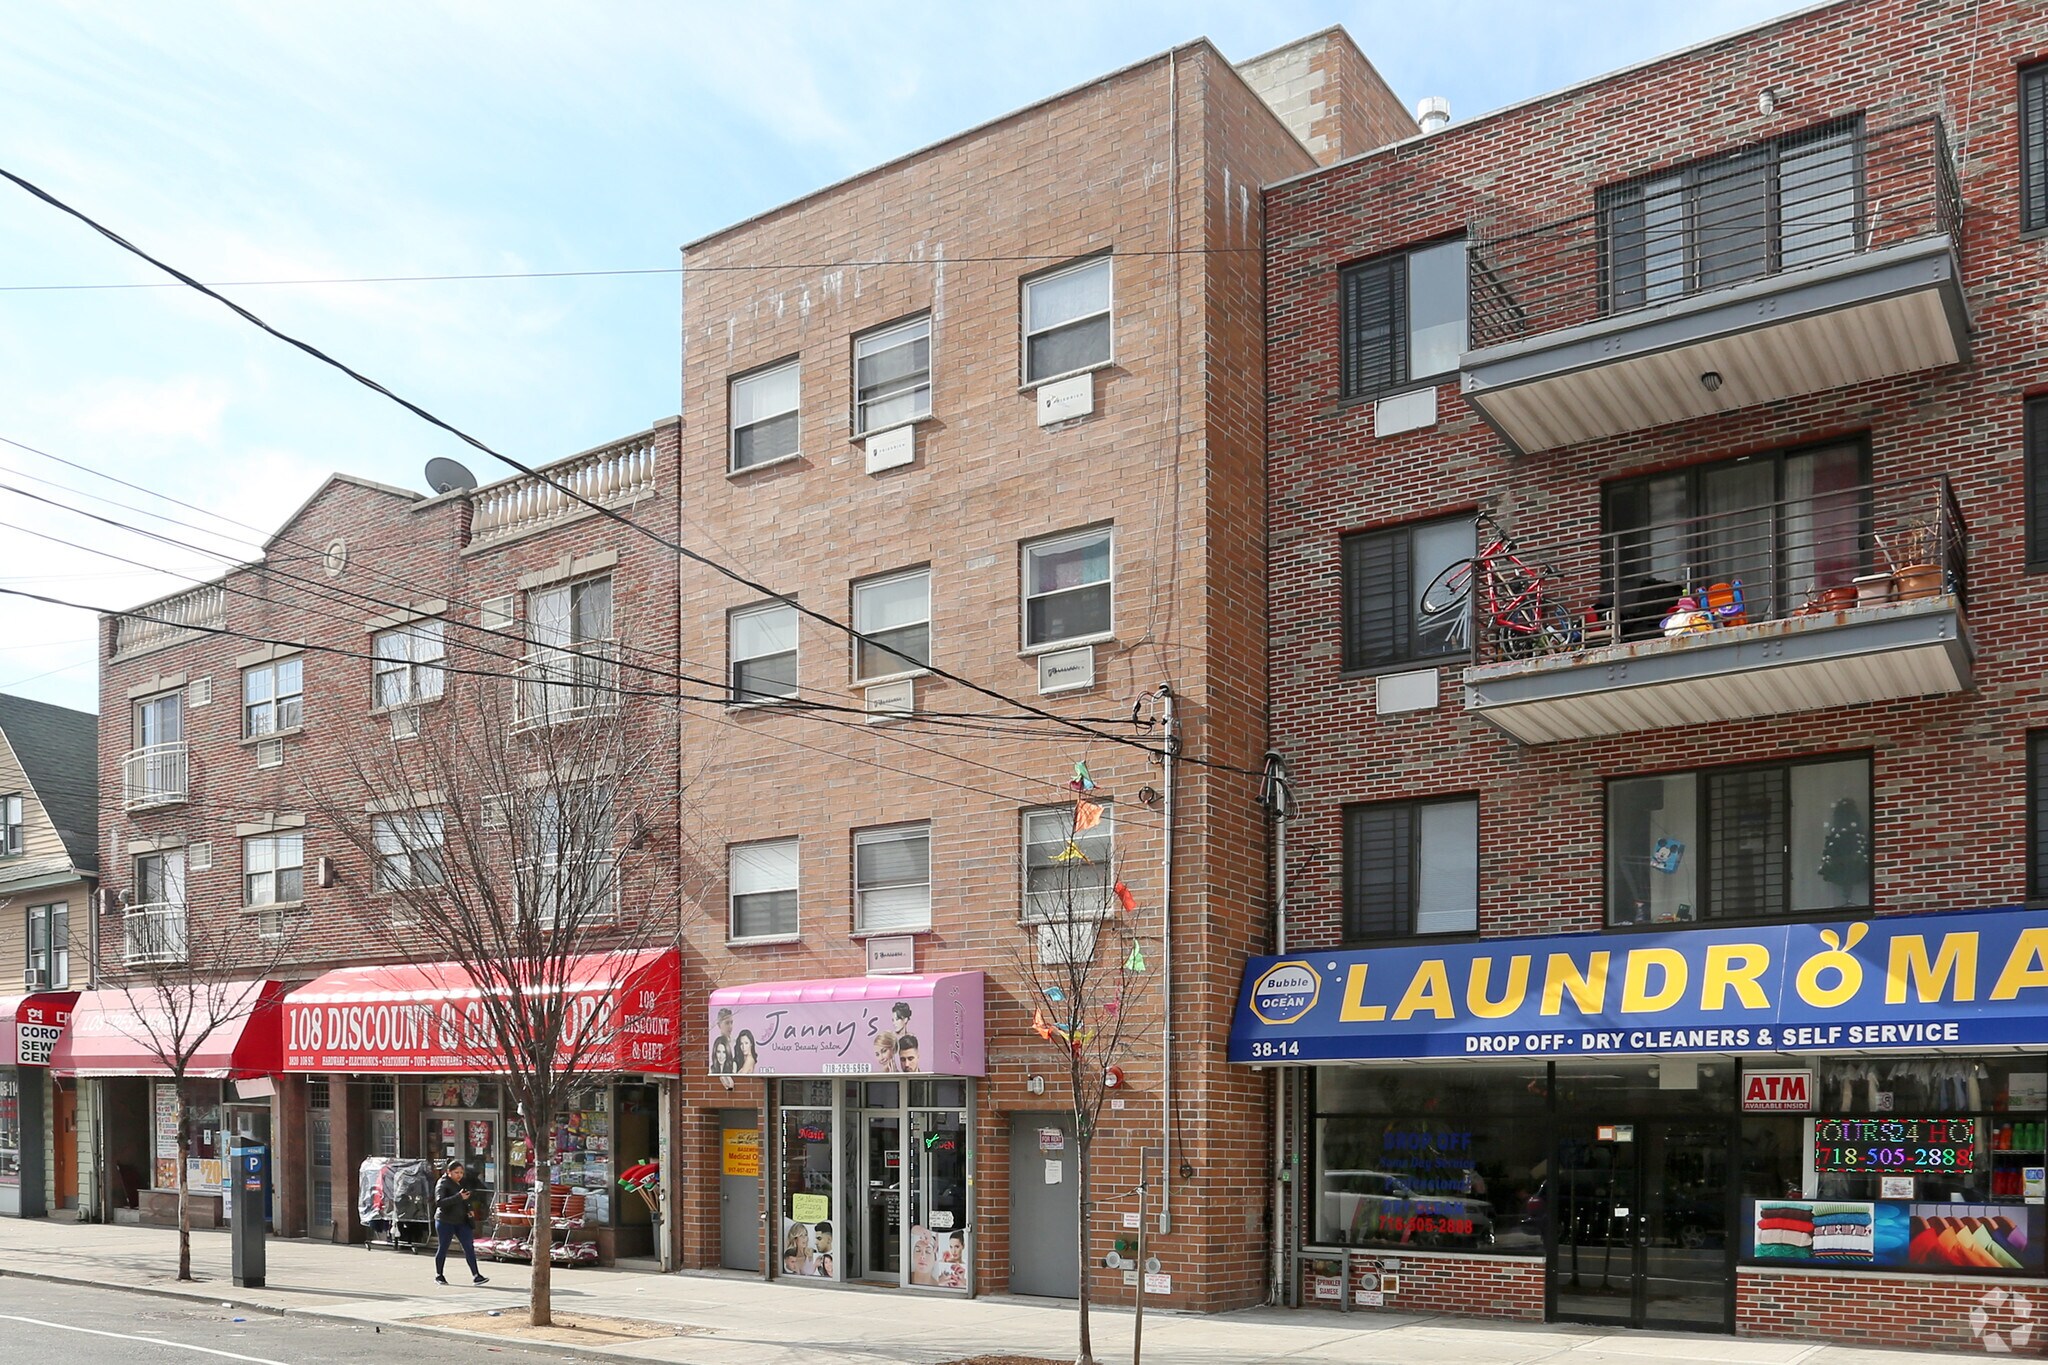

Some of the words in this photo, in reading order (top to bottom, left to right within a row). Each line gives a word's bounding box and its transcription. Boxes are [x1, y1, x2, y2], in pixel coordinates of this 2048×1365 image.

[1267, 978, 1309, 988] Bubble
[639, 990, 655, 1009] 108
[1262, 997, 1305, 1008] OCEAN
[21, 1026, 62, 1039] CORO
[288, 1007, 322, 1051] 108
[326, 1005, 433, 1051] DISCOUNT
[439, 1002, 459, 1051] &
[624, 1015, 669, 1035] DISCOUNT
[756, 1008, 879, 1057] Janny's
[1465, 1035, 1520, 1052] DROP
[1581, 1033, 1626, 1050] DRY
[1630, 1028, 1750, 1049] CLEANERS
[1756, 1028, 1773, 1046] &
[1782, 1026, 1842, 1046] SELF
[1848, 1023, 1960, 1044] SERVICE
[632, 1041, 641, 1060] &
[642, 1041, 664, 1061] GIFT
[795, 1043, 818, 1053] Beauty
[820, 1042, 841, 1051] Salon
[1252, 1041, 1300, 1057] 38-14
[1747, 1076, 1806, 1100] ATM
[1745, 1102, 1782, 1110] AVAILABLE
[1383, 1132, 1433, 1150] DROP
[1437, 1132, 1472, 1150] OFF
[249, 1157, 259, 1171] P
[728, 1152, 752, 1160] Medical
[1820, 1148, 1970, 1166] 718-505-2888
